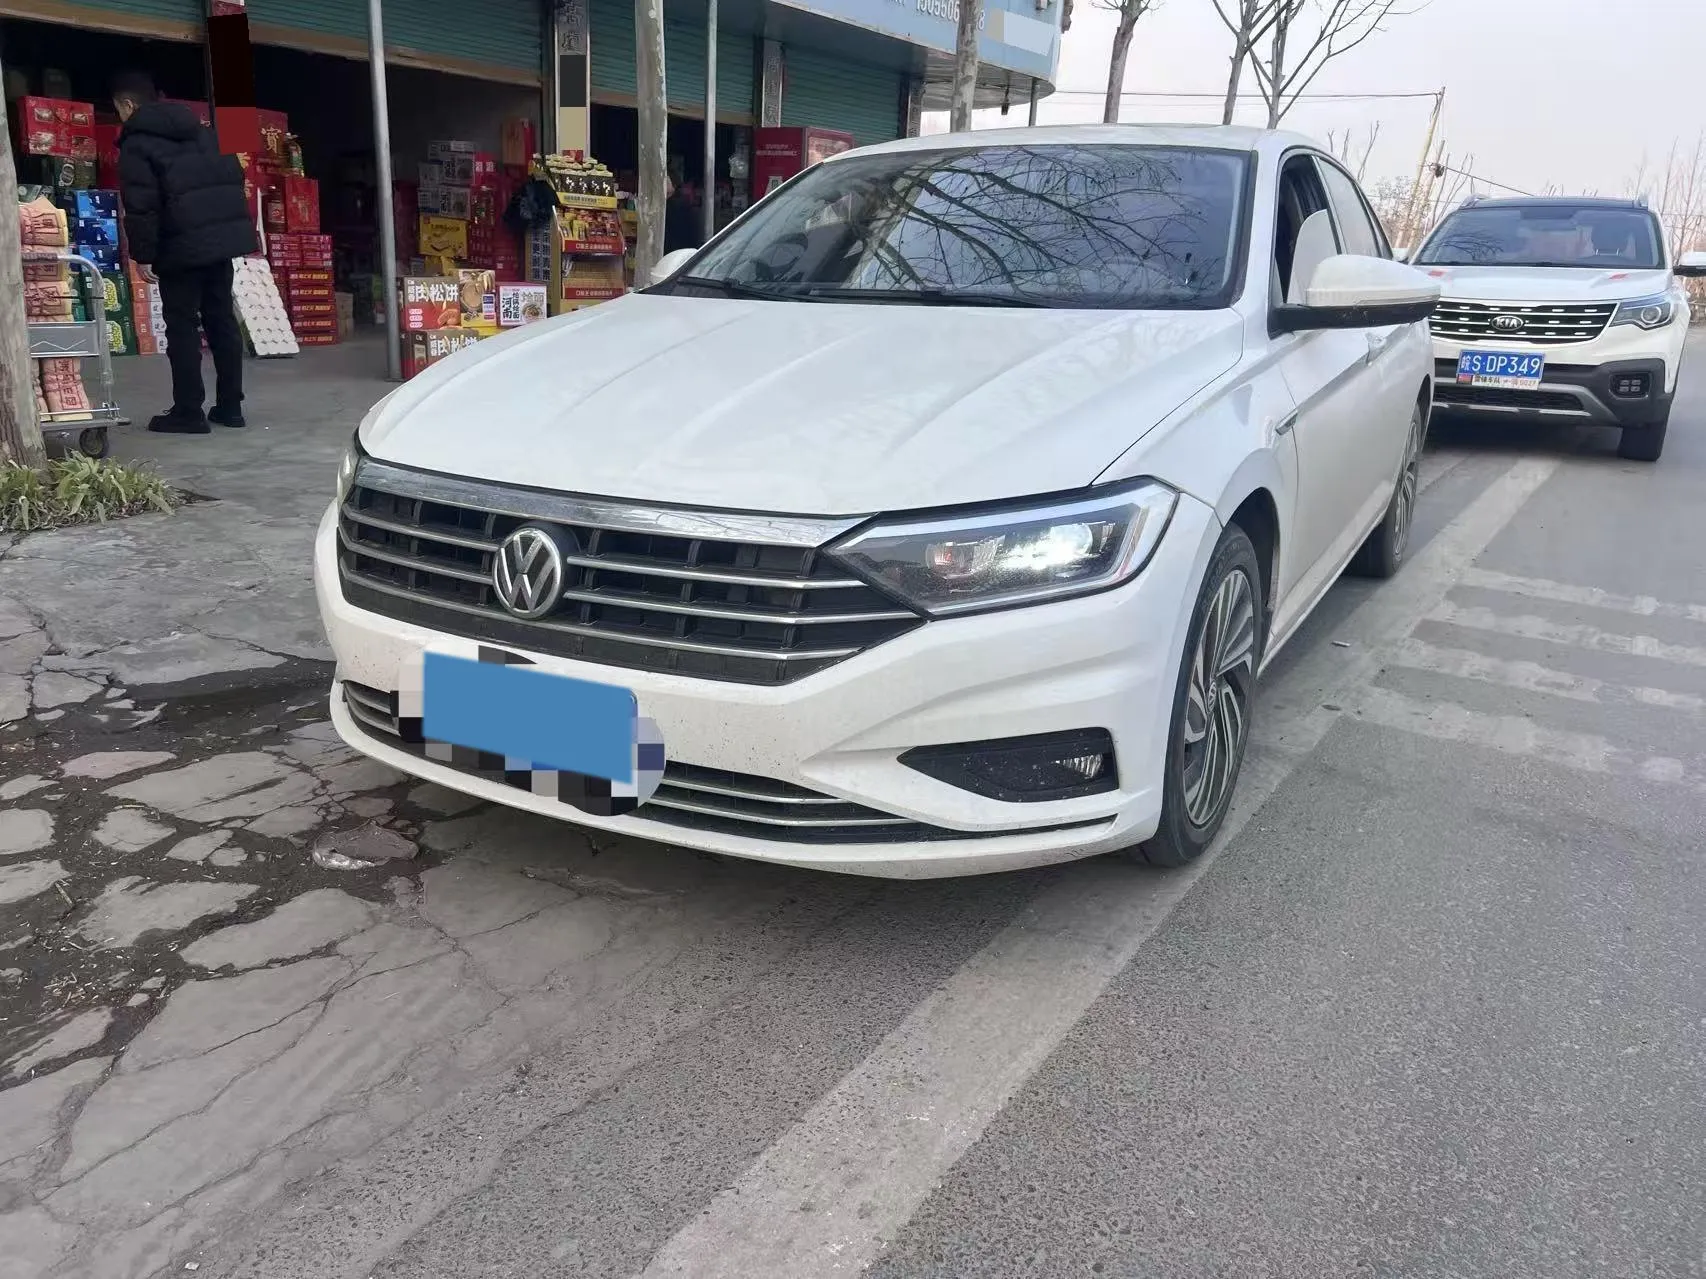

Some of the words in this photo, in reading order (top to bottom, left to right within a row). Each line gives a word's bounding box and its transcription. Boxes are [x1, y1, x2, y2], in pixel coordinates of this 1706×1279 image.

[415, 283, 459, 303] 肉松饼
[502, 297, 512, 319] 河南
[1495, 317, 1518, 328] KIA
